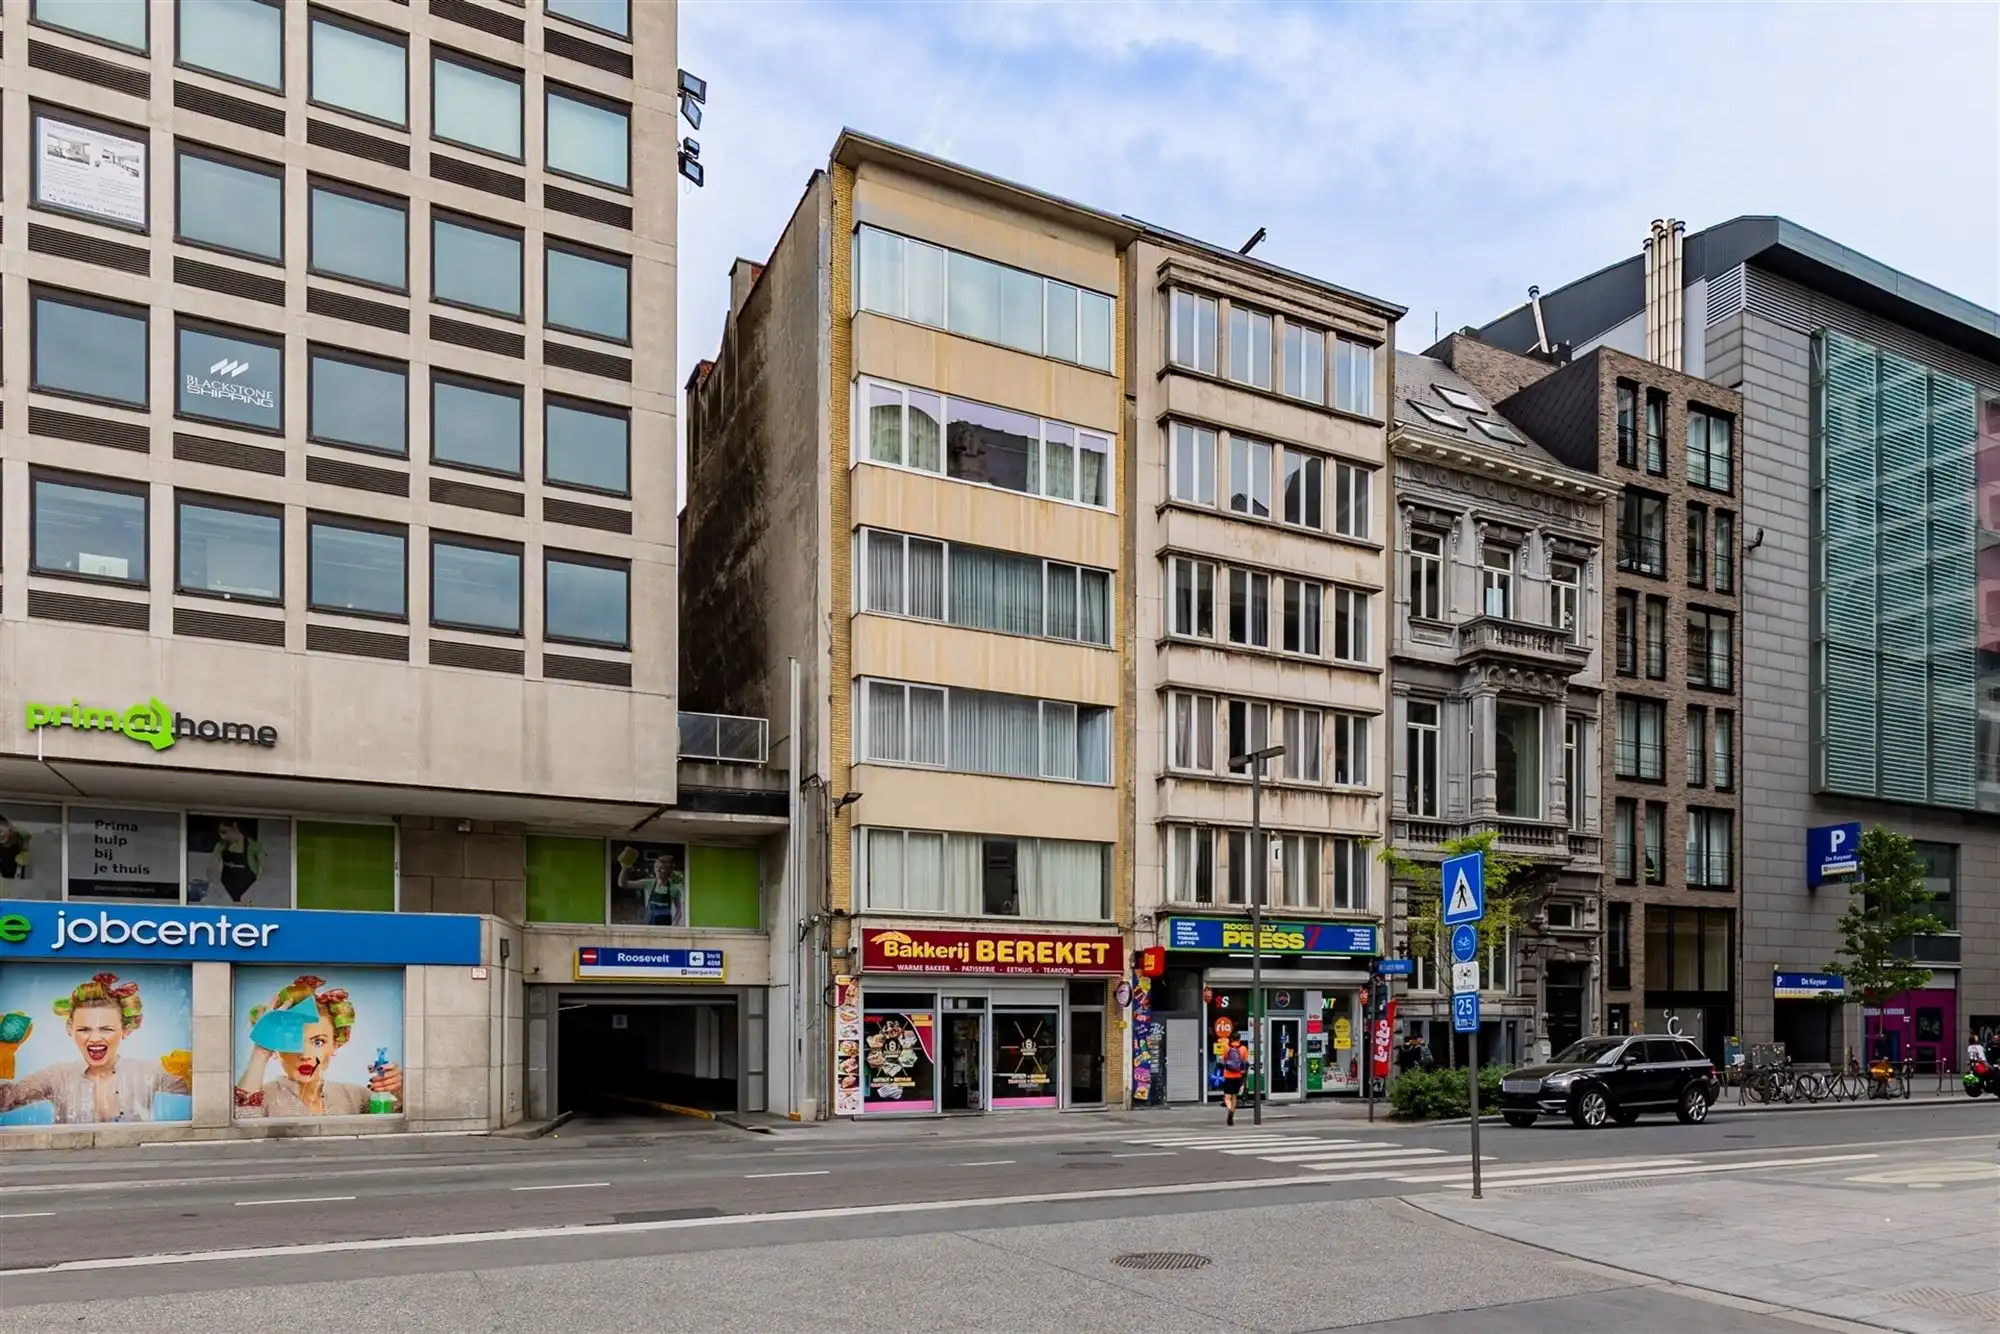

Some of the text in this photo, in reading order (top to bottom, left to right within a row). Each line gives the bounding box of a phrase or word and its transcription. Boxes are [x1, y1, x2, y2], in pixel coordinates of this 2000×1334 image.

[187, 375, 273, 399] BLACKSTONE
[187, 384, 274, 408] SHIPPING
[94, 819, 138, 833] Prima
[94, 834, 128, 847] hulp
[1831, 829, 1845, 852] P
[94, 849, 113, 861] bij
[94, 864, 150, 875] je thuis
[51, 910, 279, 949] jobcenter
[1223, 923, 1277, 932] ROOSEELT
[1223, 931, 1305, 950] PRESS
[617, 952, 670, 963] Roosevelt
[885, 939, 1109, 964] Bakkerij BEREKET
[897, 964, 923, 972] WARME
[1458, 999, 1473, 1015] 25
